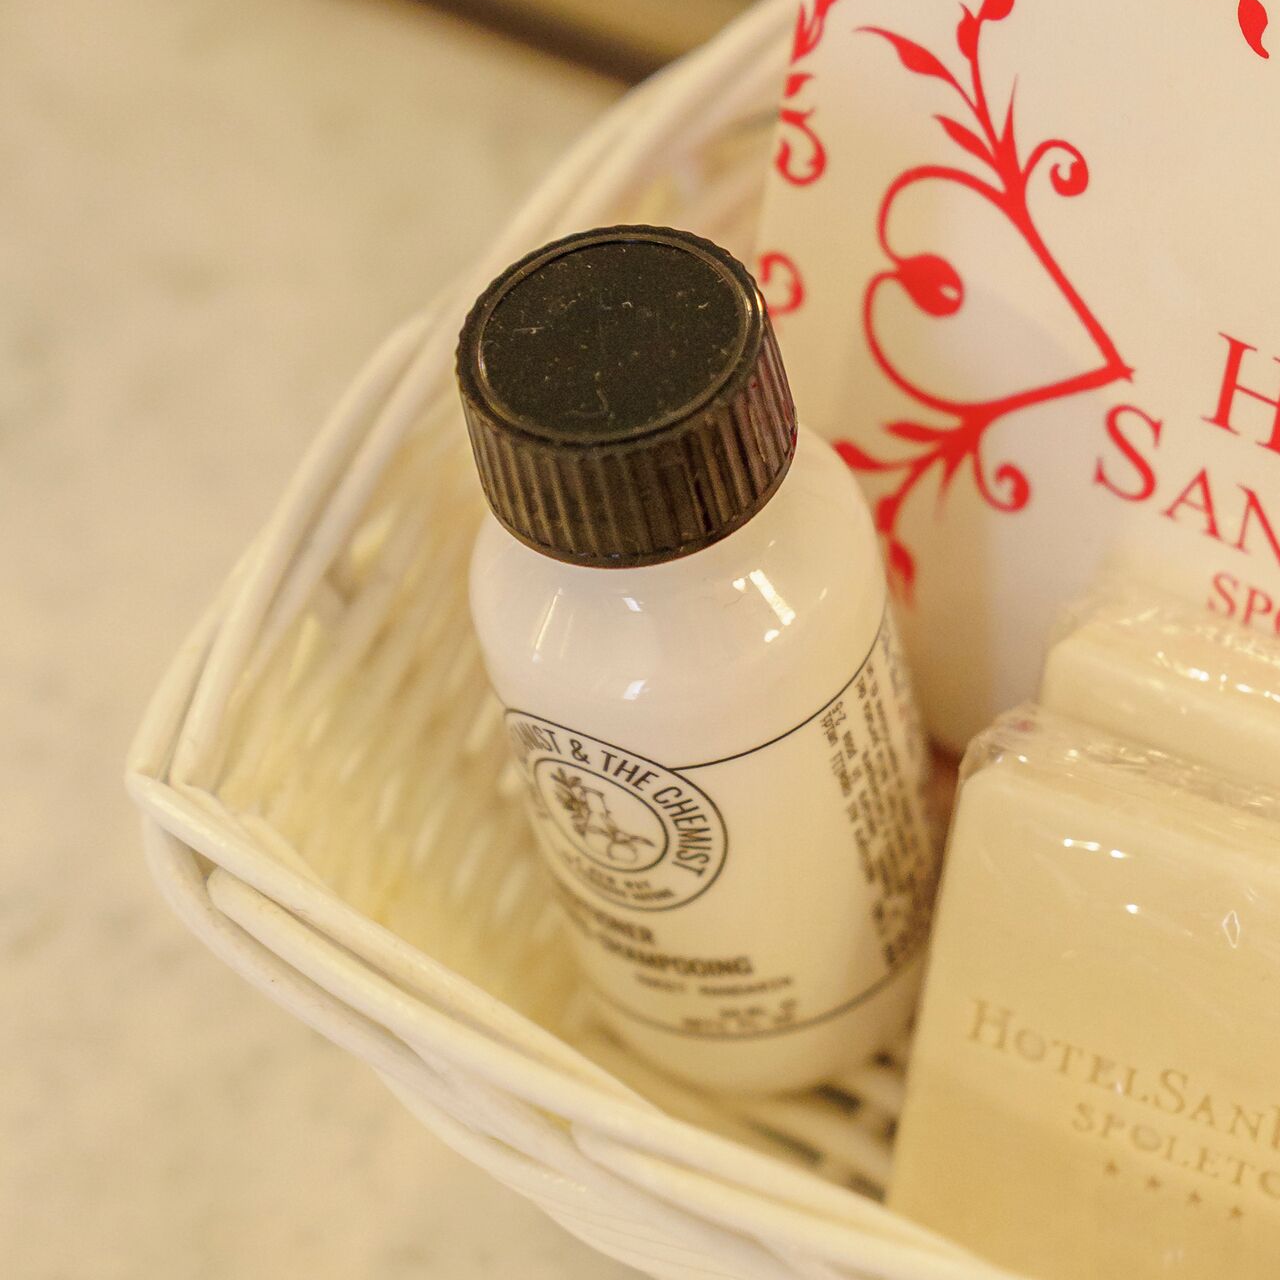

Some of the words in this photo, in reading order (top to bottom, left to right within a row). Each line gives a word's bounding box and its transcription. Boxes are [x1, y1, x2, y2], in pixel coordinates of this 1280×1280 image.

[569, 738, 591, 765] &
[601, 749, 660, 792] THE
[652, 785, 713, 878] CHEMIST
